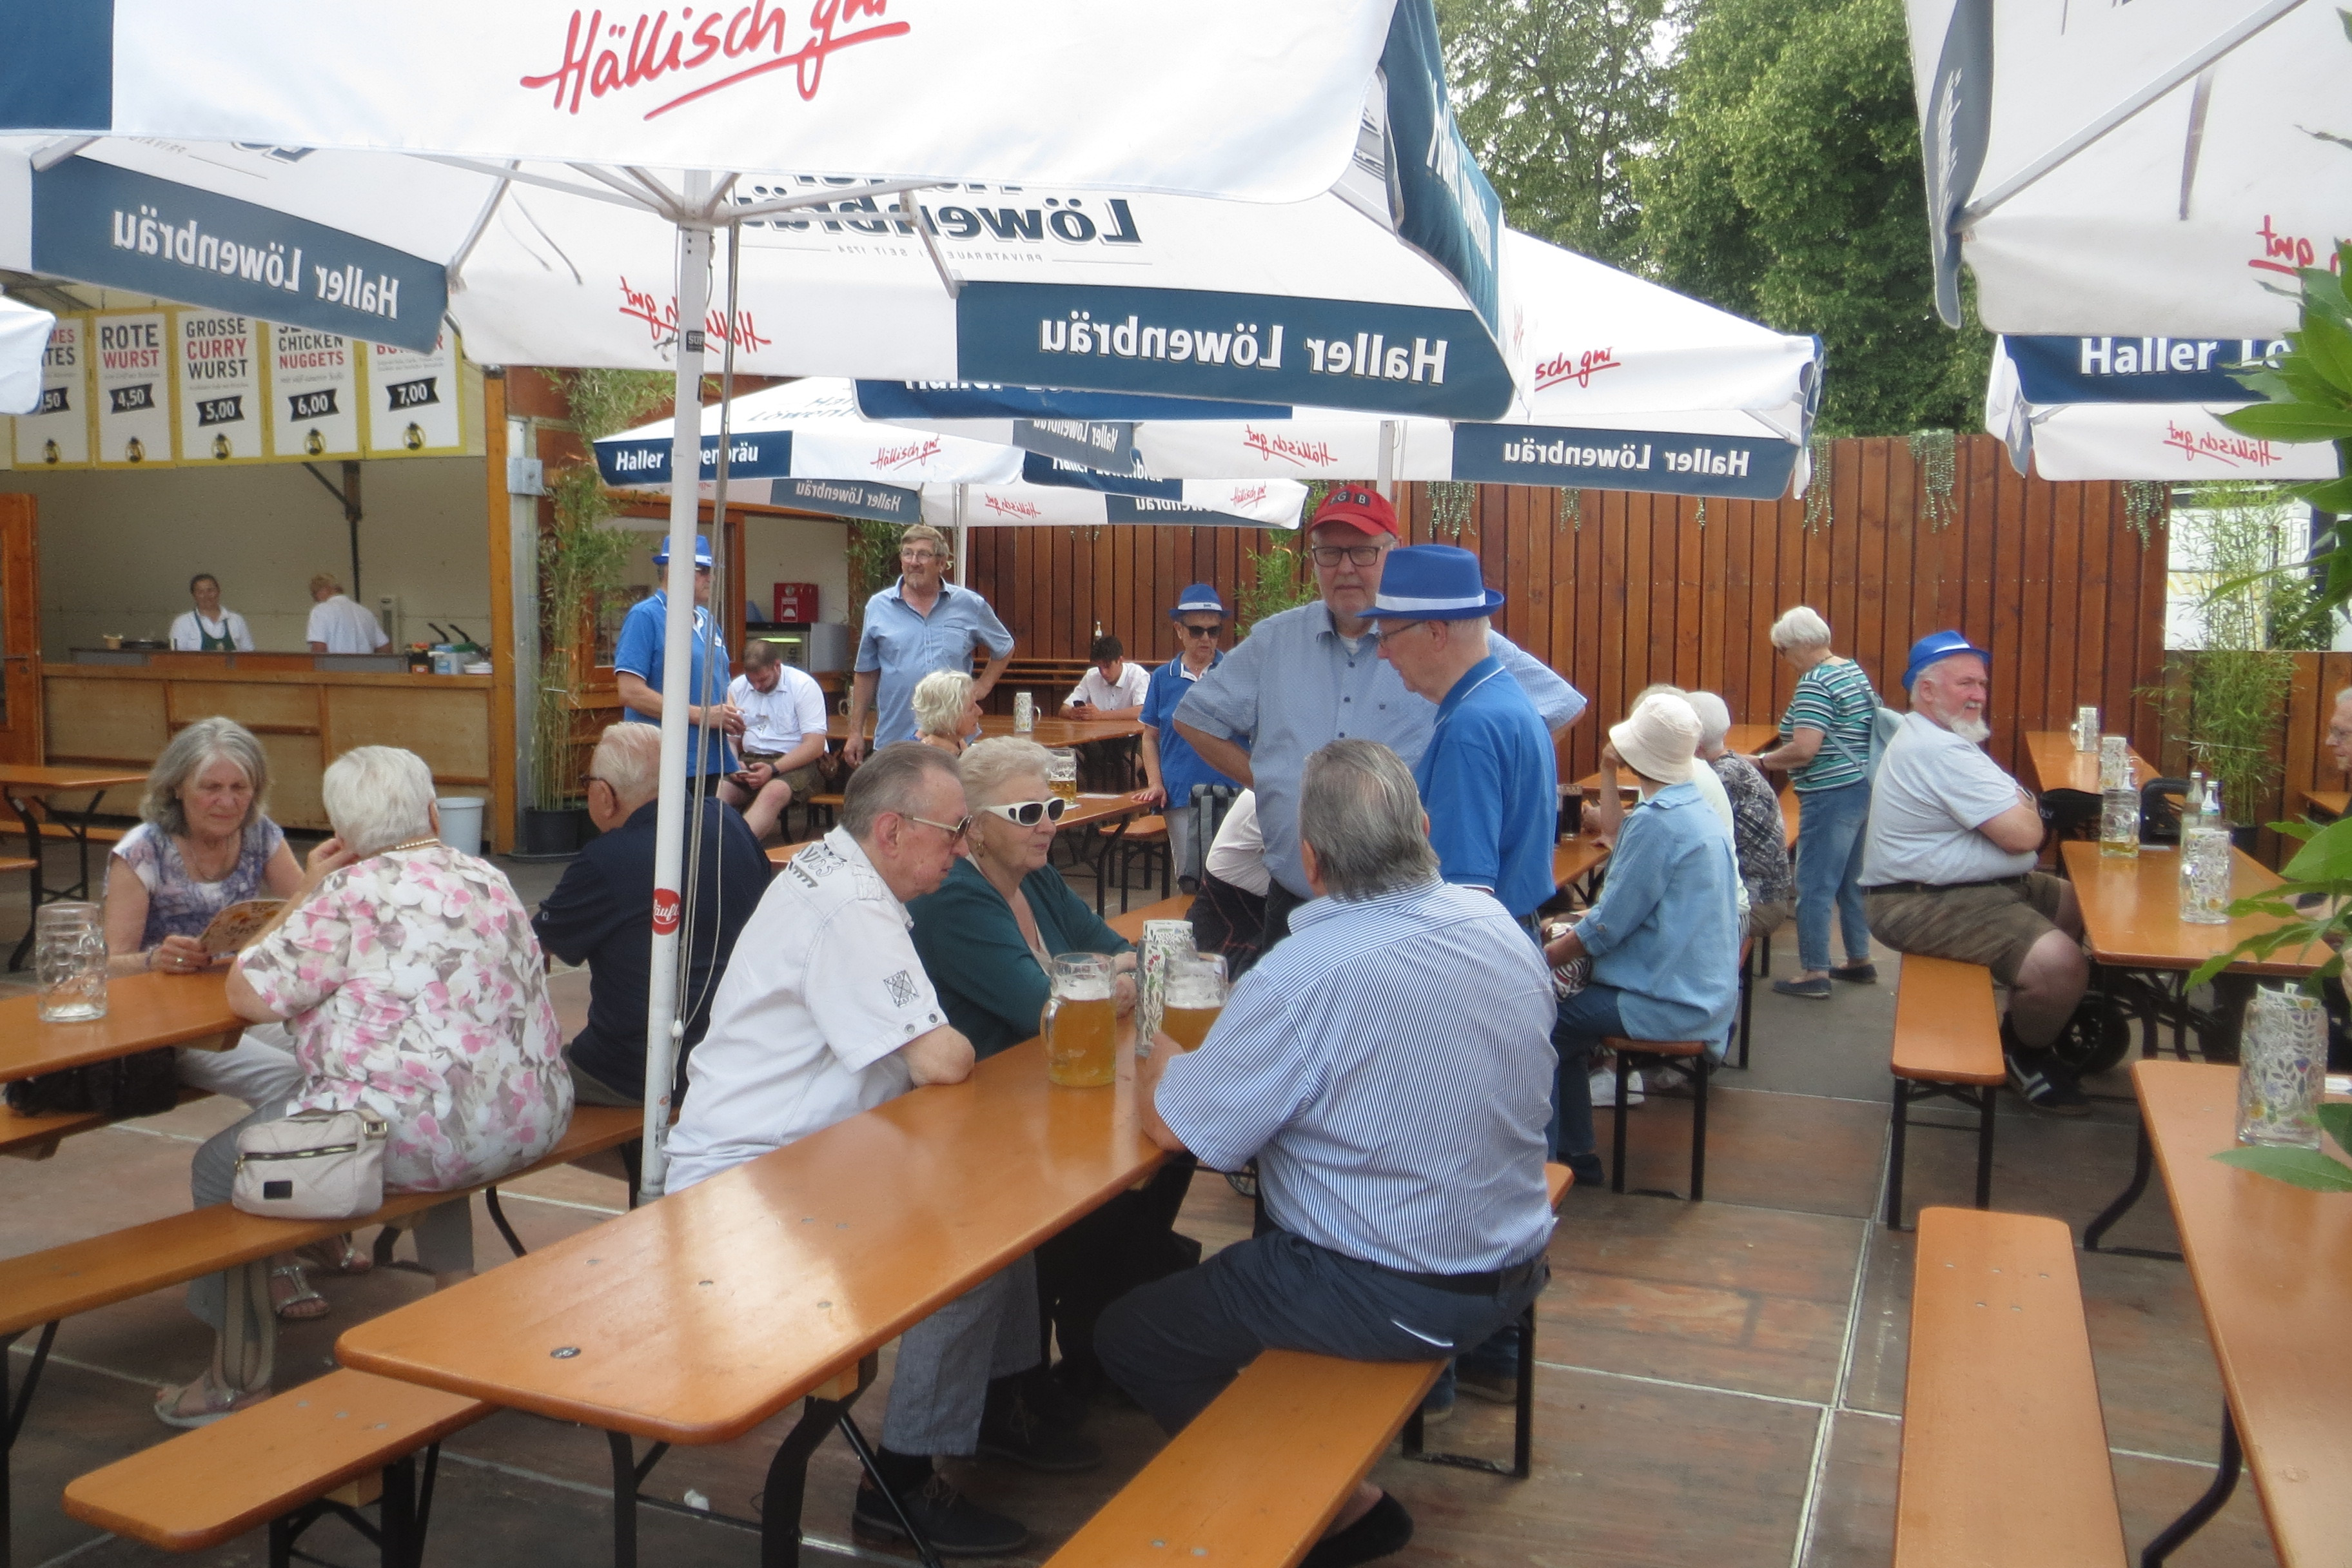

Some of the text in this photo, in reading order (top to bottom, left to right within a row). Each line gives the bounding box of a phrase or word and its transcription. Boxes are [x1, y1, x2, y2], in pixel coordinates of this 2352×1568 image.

[102, 324, 159, 349] ROTE
[186, 318, 247, 338] GROSSE
[186, 338, 247, 360] CURRY
[278, 335, 344, 353] CHICKEN
[103, 349, 159, 369] WURST
[279, 351, 344, 369] NUGGETS
[2081, 337, 2219, 375] Haller
[188, 358, 248, 380] WURST
[118, 389, 144, 409] 4,50
[297, 394, 329, 417] 6,00
[397, 384, 427, 406] 7,00
[205, 400, 235, 421] 5,00
[616, 450, 665, 471] Haller
